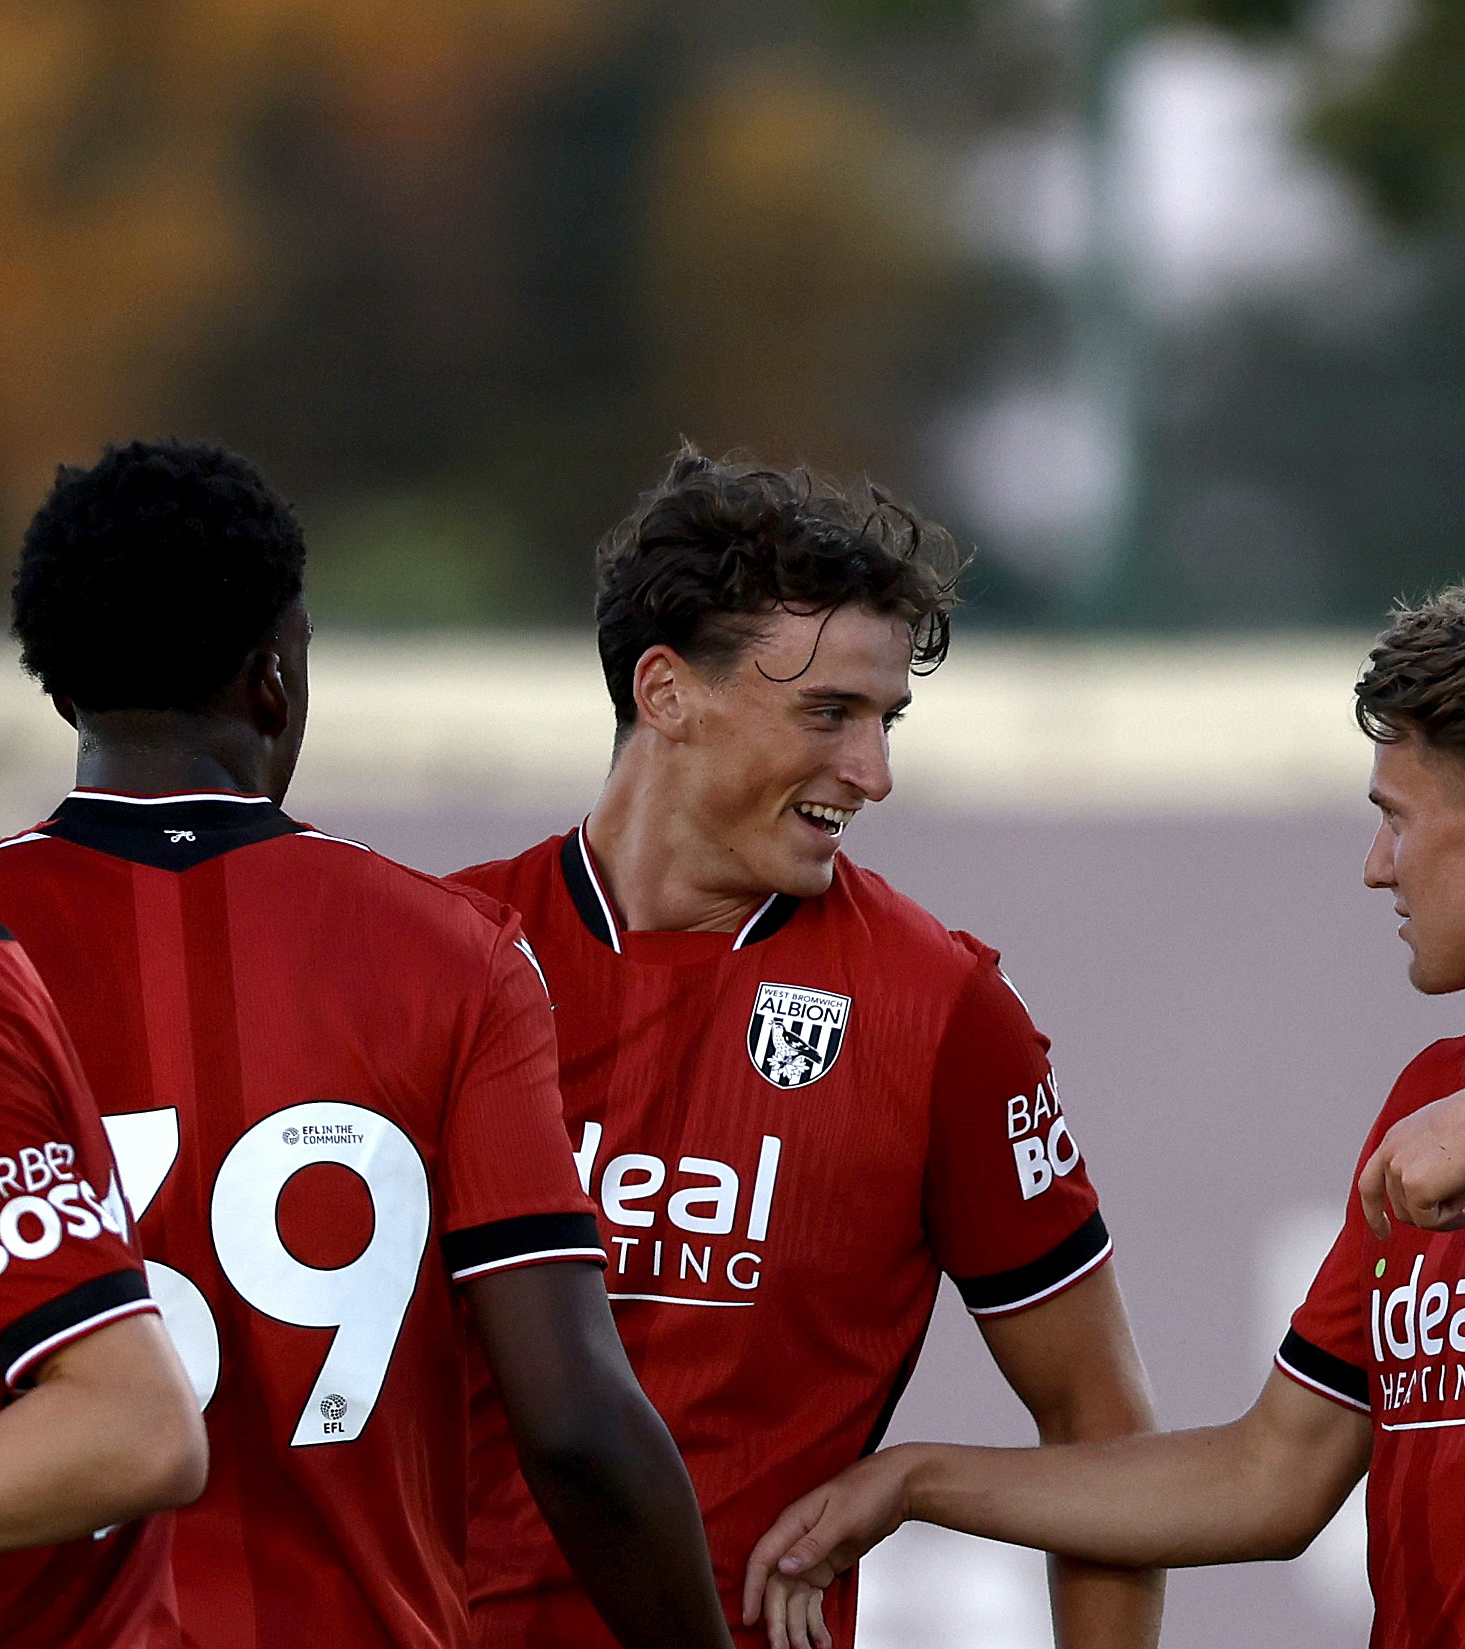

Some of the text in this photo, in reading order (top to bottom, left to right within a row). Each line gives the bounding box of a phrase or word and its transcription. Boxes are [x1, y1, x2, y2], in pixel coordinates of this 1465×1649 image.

[764, 988, 843, 1007] WEST BROMWICH
[760, 997, 841, 1024] ALBION
[302, 1125, 353, 1135] EFL IN THE
[303, 1134, 364, 1145] COMMUNITY
[572, 1121, 782, 1242] eal
[611, 1236, 762, 1290] TING
[323, 1423, 345, 1434] EFL
